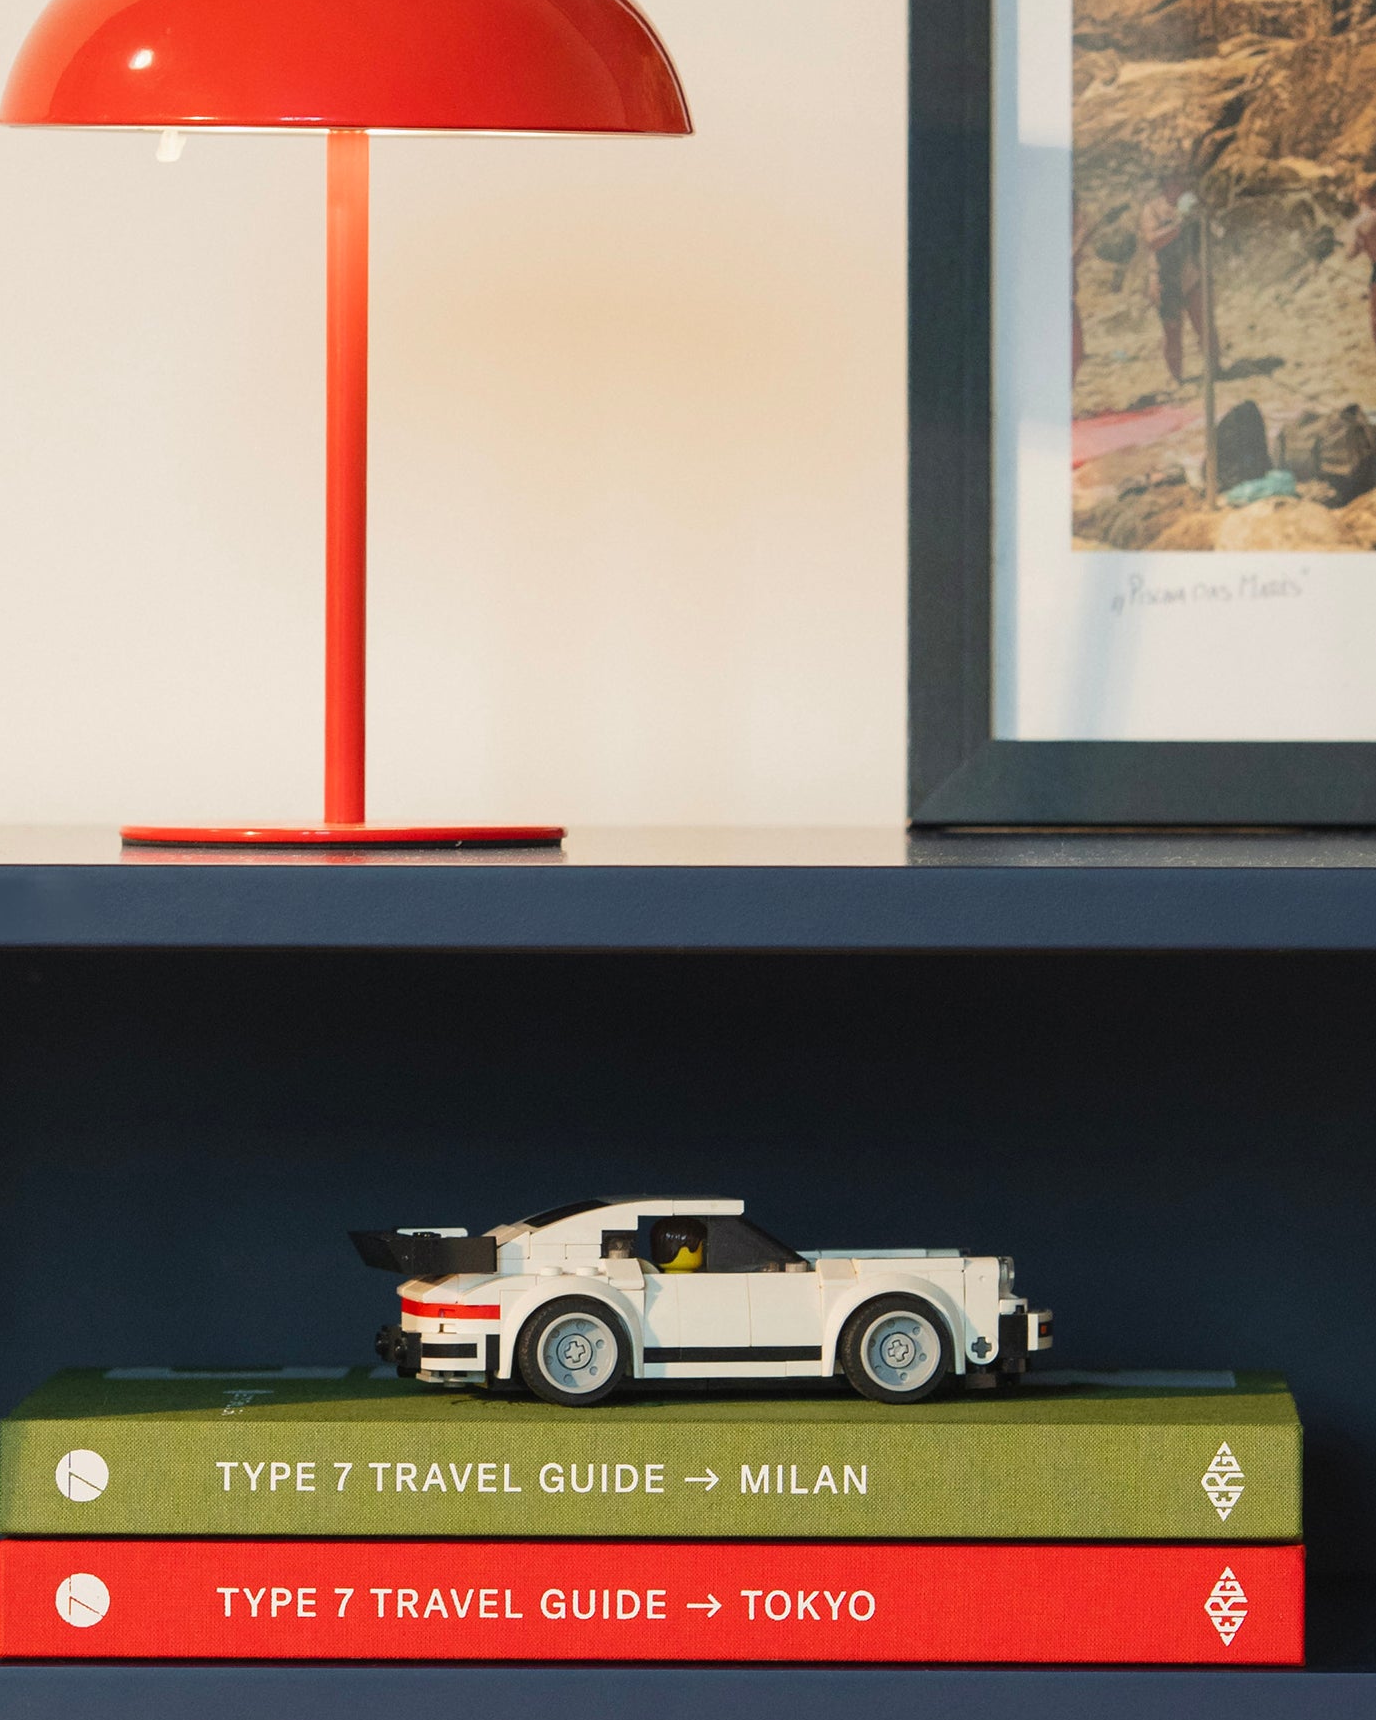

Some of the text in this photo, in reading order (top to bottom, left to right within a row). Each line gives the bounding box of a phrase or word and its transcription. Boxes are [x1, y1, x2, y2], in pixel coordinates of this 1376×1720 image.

[215, 1461, 867, 1495] TYPE 7 TRAVEL GUIDE MILAN
[216, 1587, 876, 1621] TYPE 7 TRAVEL GUIDE TOKYO
